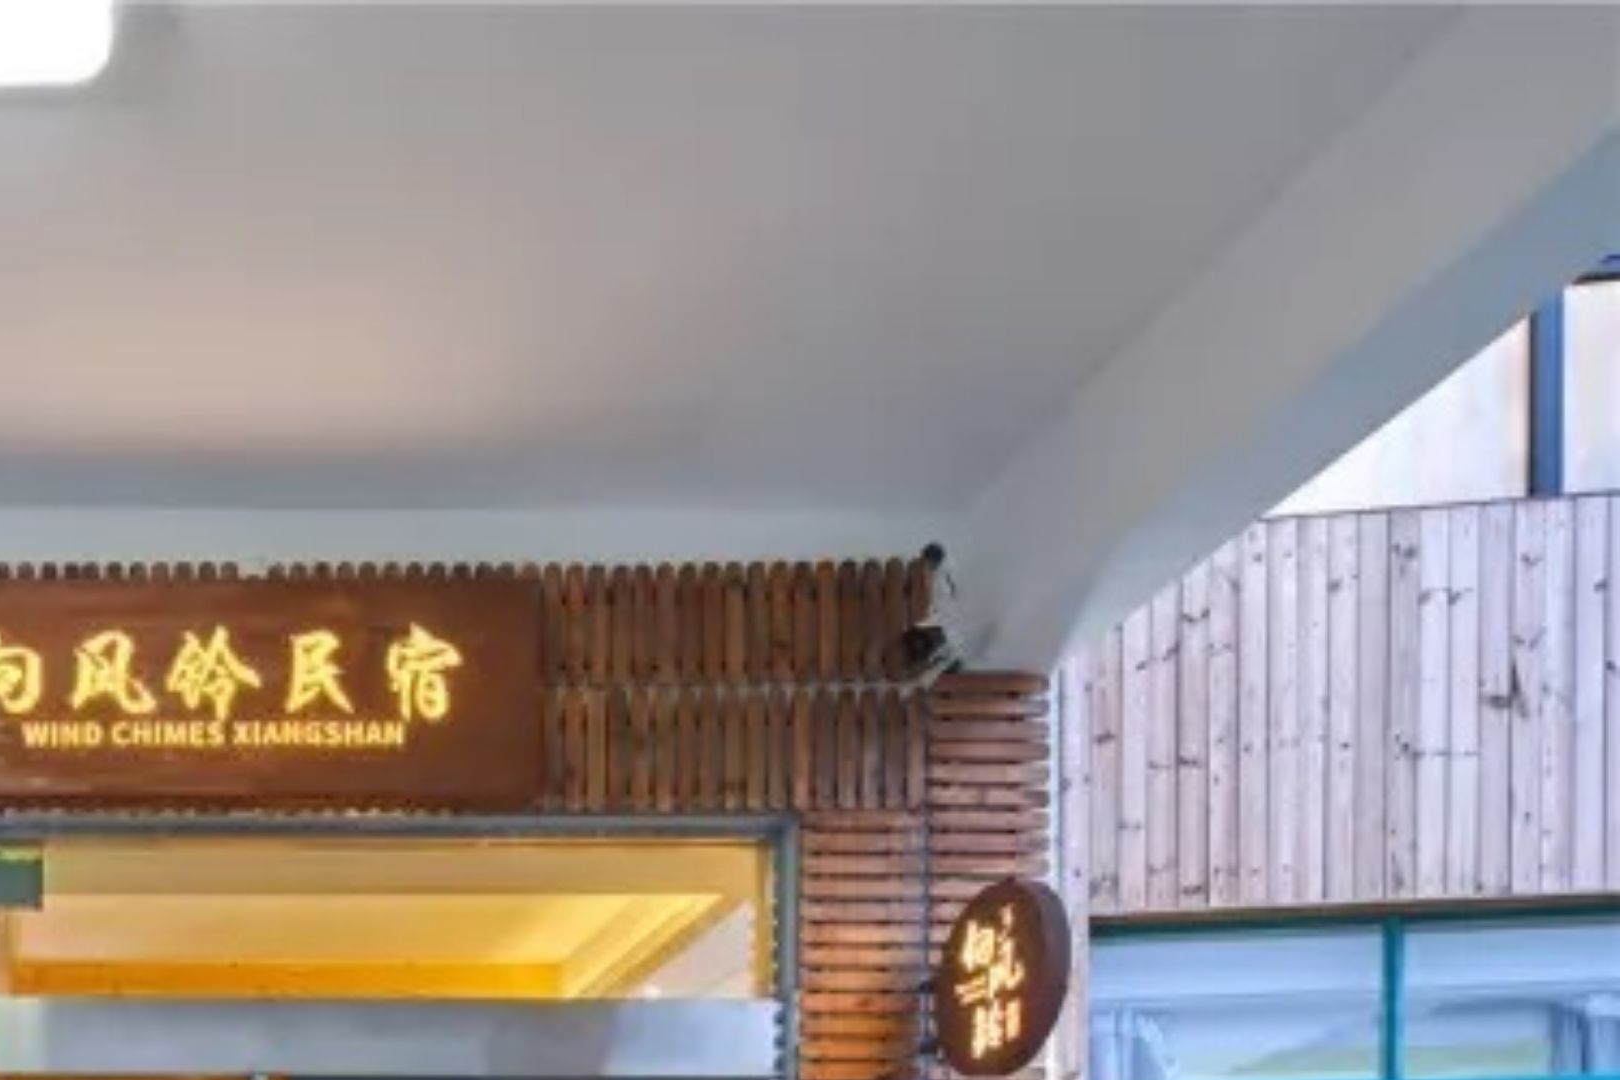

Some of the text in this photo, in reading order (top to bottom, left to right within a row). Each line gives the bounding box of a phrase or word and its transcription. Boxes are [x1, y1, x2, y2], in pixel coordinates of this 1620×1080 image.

[21, 721, 405, 748] WIND CHIMES XIANGSHAN
